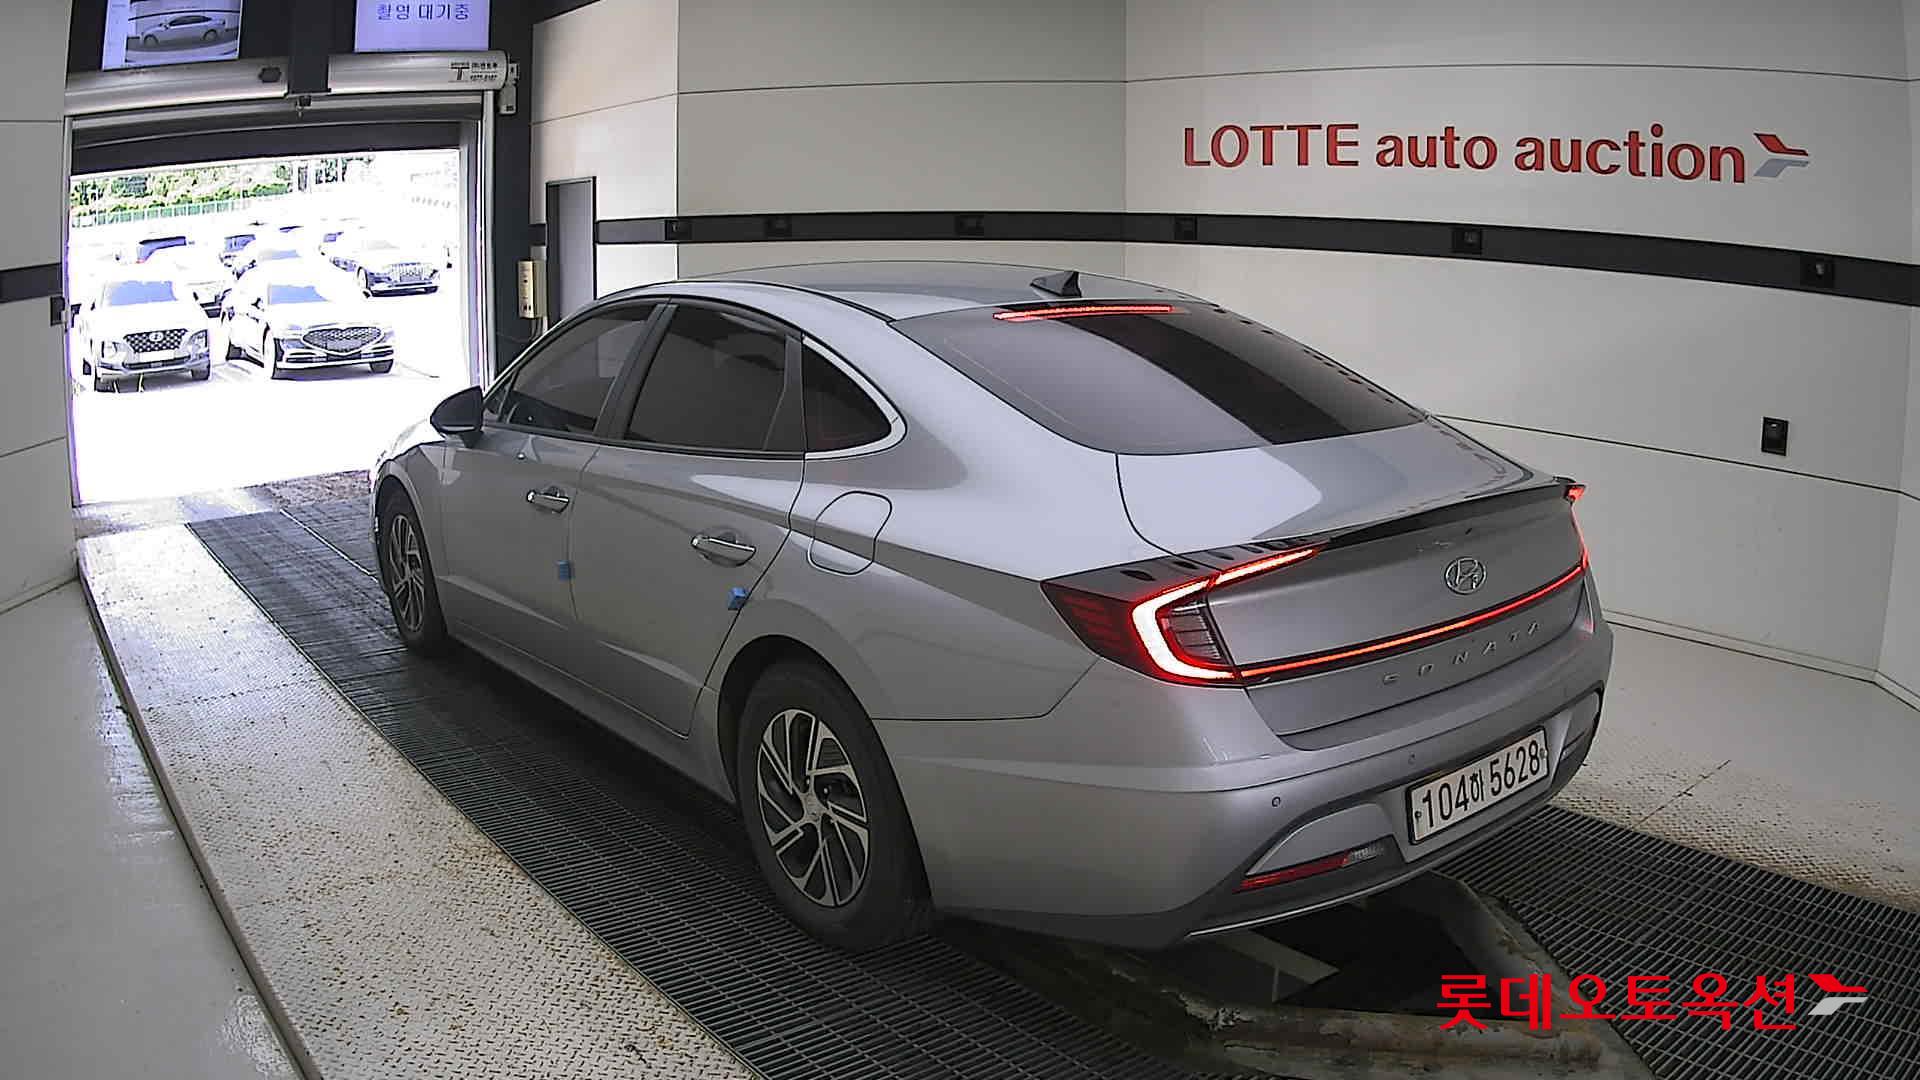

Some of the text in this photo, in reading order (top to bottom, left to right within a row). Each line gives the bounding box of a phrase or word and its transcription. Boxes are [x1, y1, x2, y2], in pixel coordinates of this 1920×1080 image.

[419, 4, 469, 20] 대기중
[1184, 122, 1747, 184] LOTTE auto auction
[1383, 622, 1539, 683] SONATA
[1489, 740, 1540, 796] 5628
